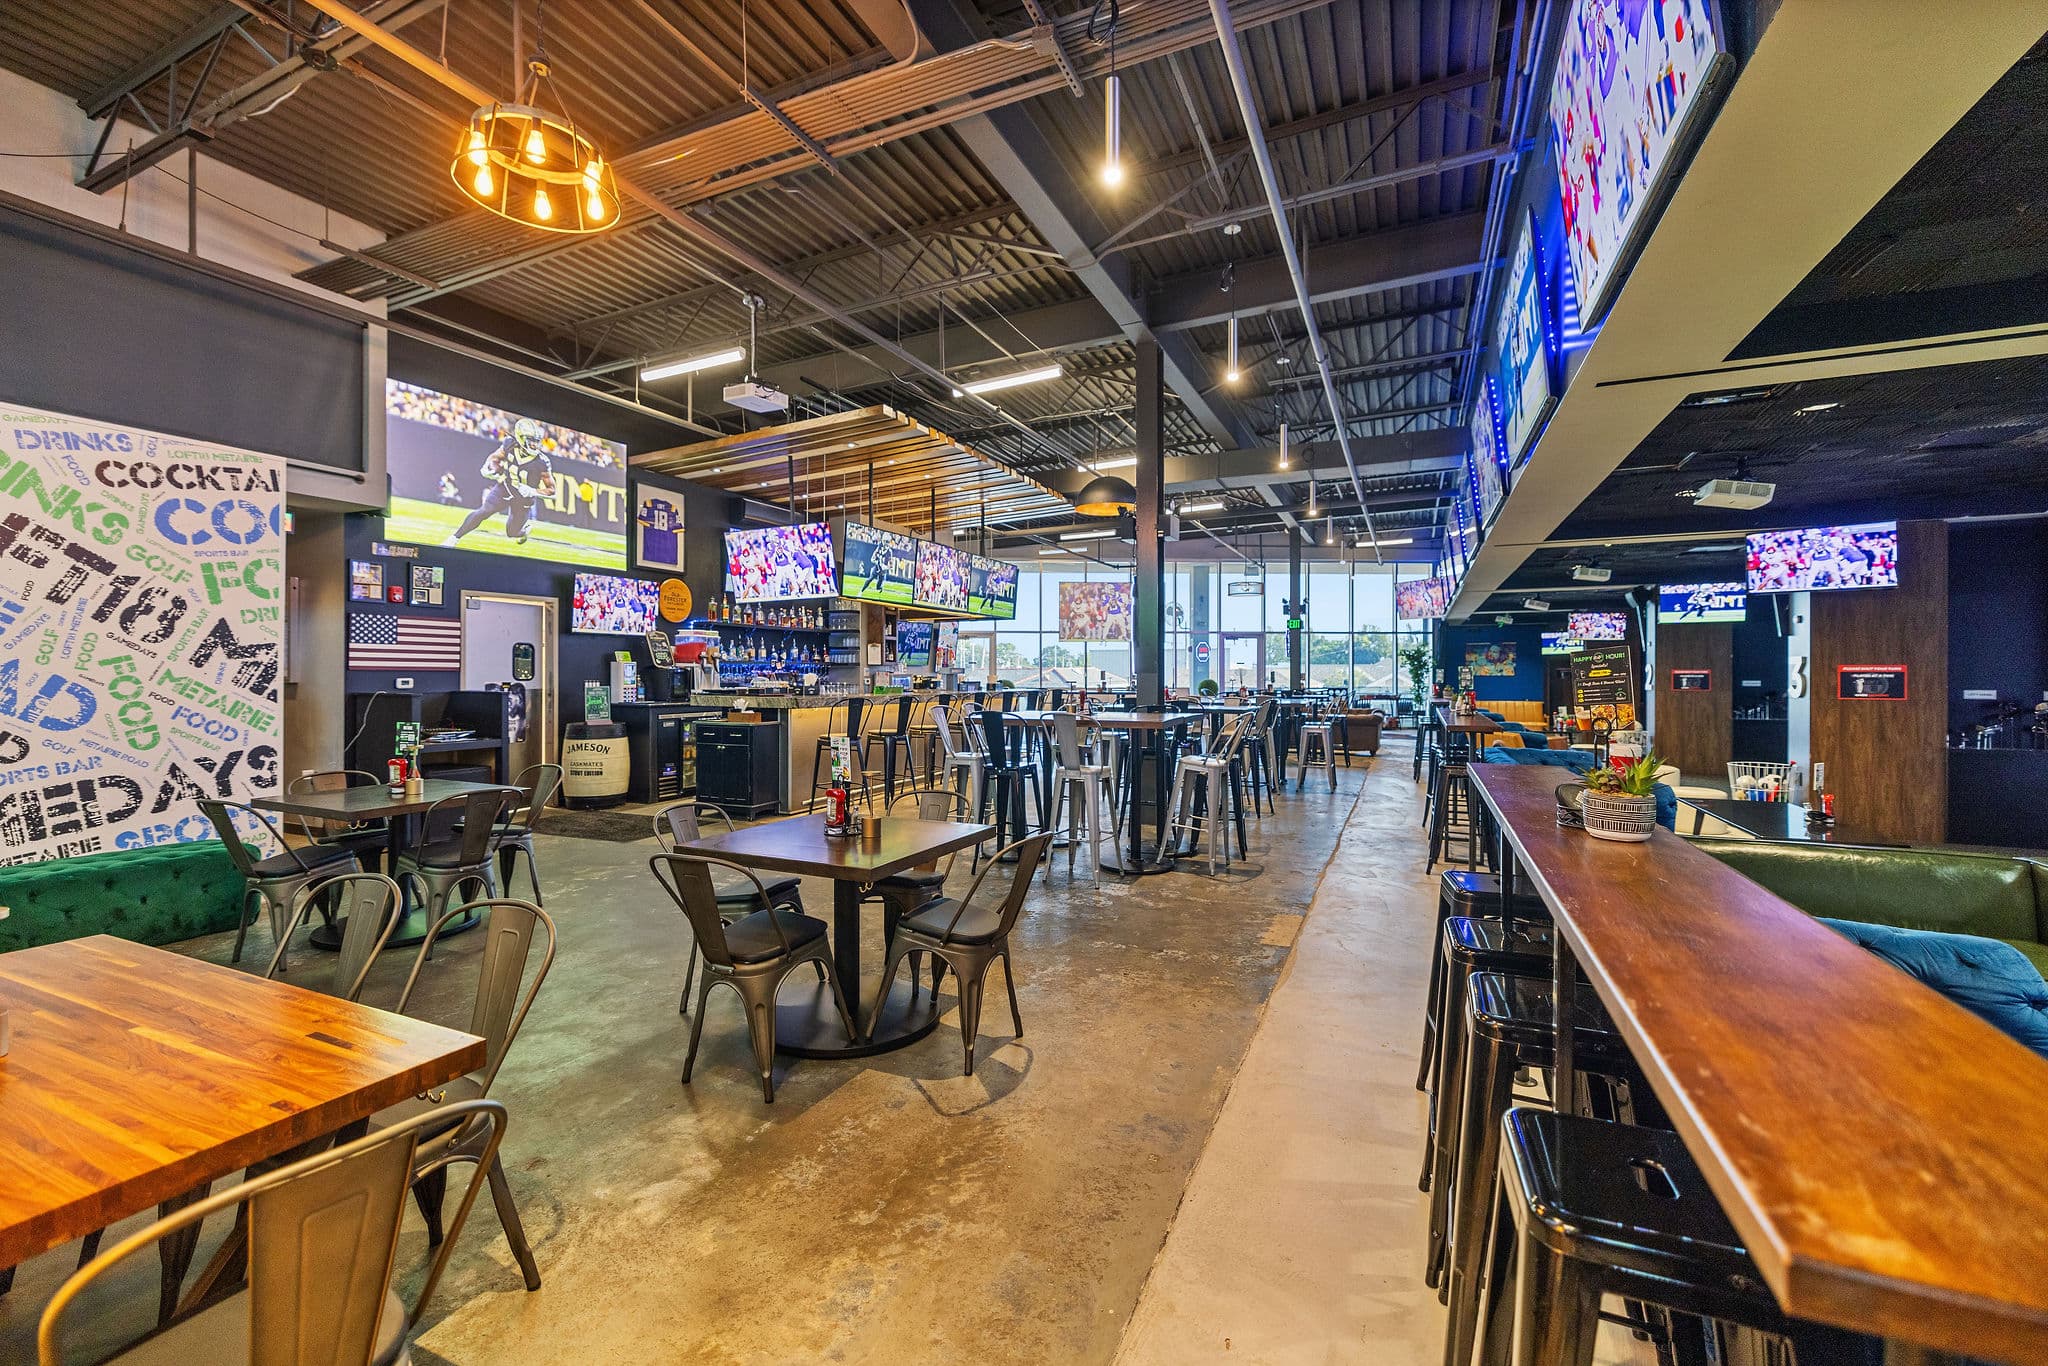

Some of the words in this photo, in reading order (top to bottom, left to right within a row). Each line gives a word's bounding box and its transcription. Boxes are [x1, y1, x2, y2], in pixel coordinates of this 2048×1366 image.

[14, 429, 134, 453] DRINKS
[62, 453, 91, 487] FOOD
[154, 498, 280, 546] CO
[654, 510, 668, 531] 18
[126, 543, 193, 583] GOLF
[20, 580, 35, 601] FOOD
[4, 613, 51, 650] GAMEDAYS
[167, 626, 197, 662] SPORTS
[191, 607, 211, 628] BAR
[1289, 619, 1300, 629] EXIT
[35, 628, 59, 666] GOLF
[74, 632, 98, 671] FOOD
[106, 632, 158, 659] GAMEDAYS
[1573, 655, 1593, 663] HAPPY
[1645, 663, 1653, 691] 2
[98, 654, 161, 751] FOOD
[148, 691, 176, 706] FOOD
[156, 668, 276, 732] METAIRIE
[169, 727, 202, 744] SPORTS
[171, 705, 239, 742] FOOD
[42, 739, 77, 755] GOLF
[80, 738, 122, 759] METAIRIE
[120, 753, 150, 768] ROAD
[567, 743, 612, 755] JAMESON
[55, 756, 103, 776] BAR
